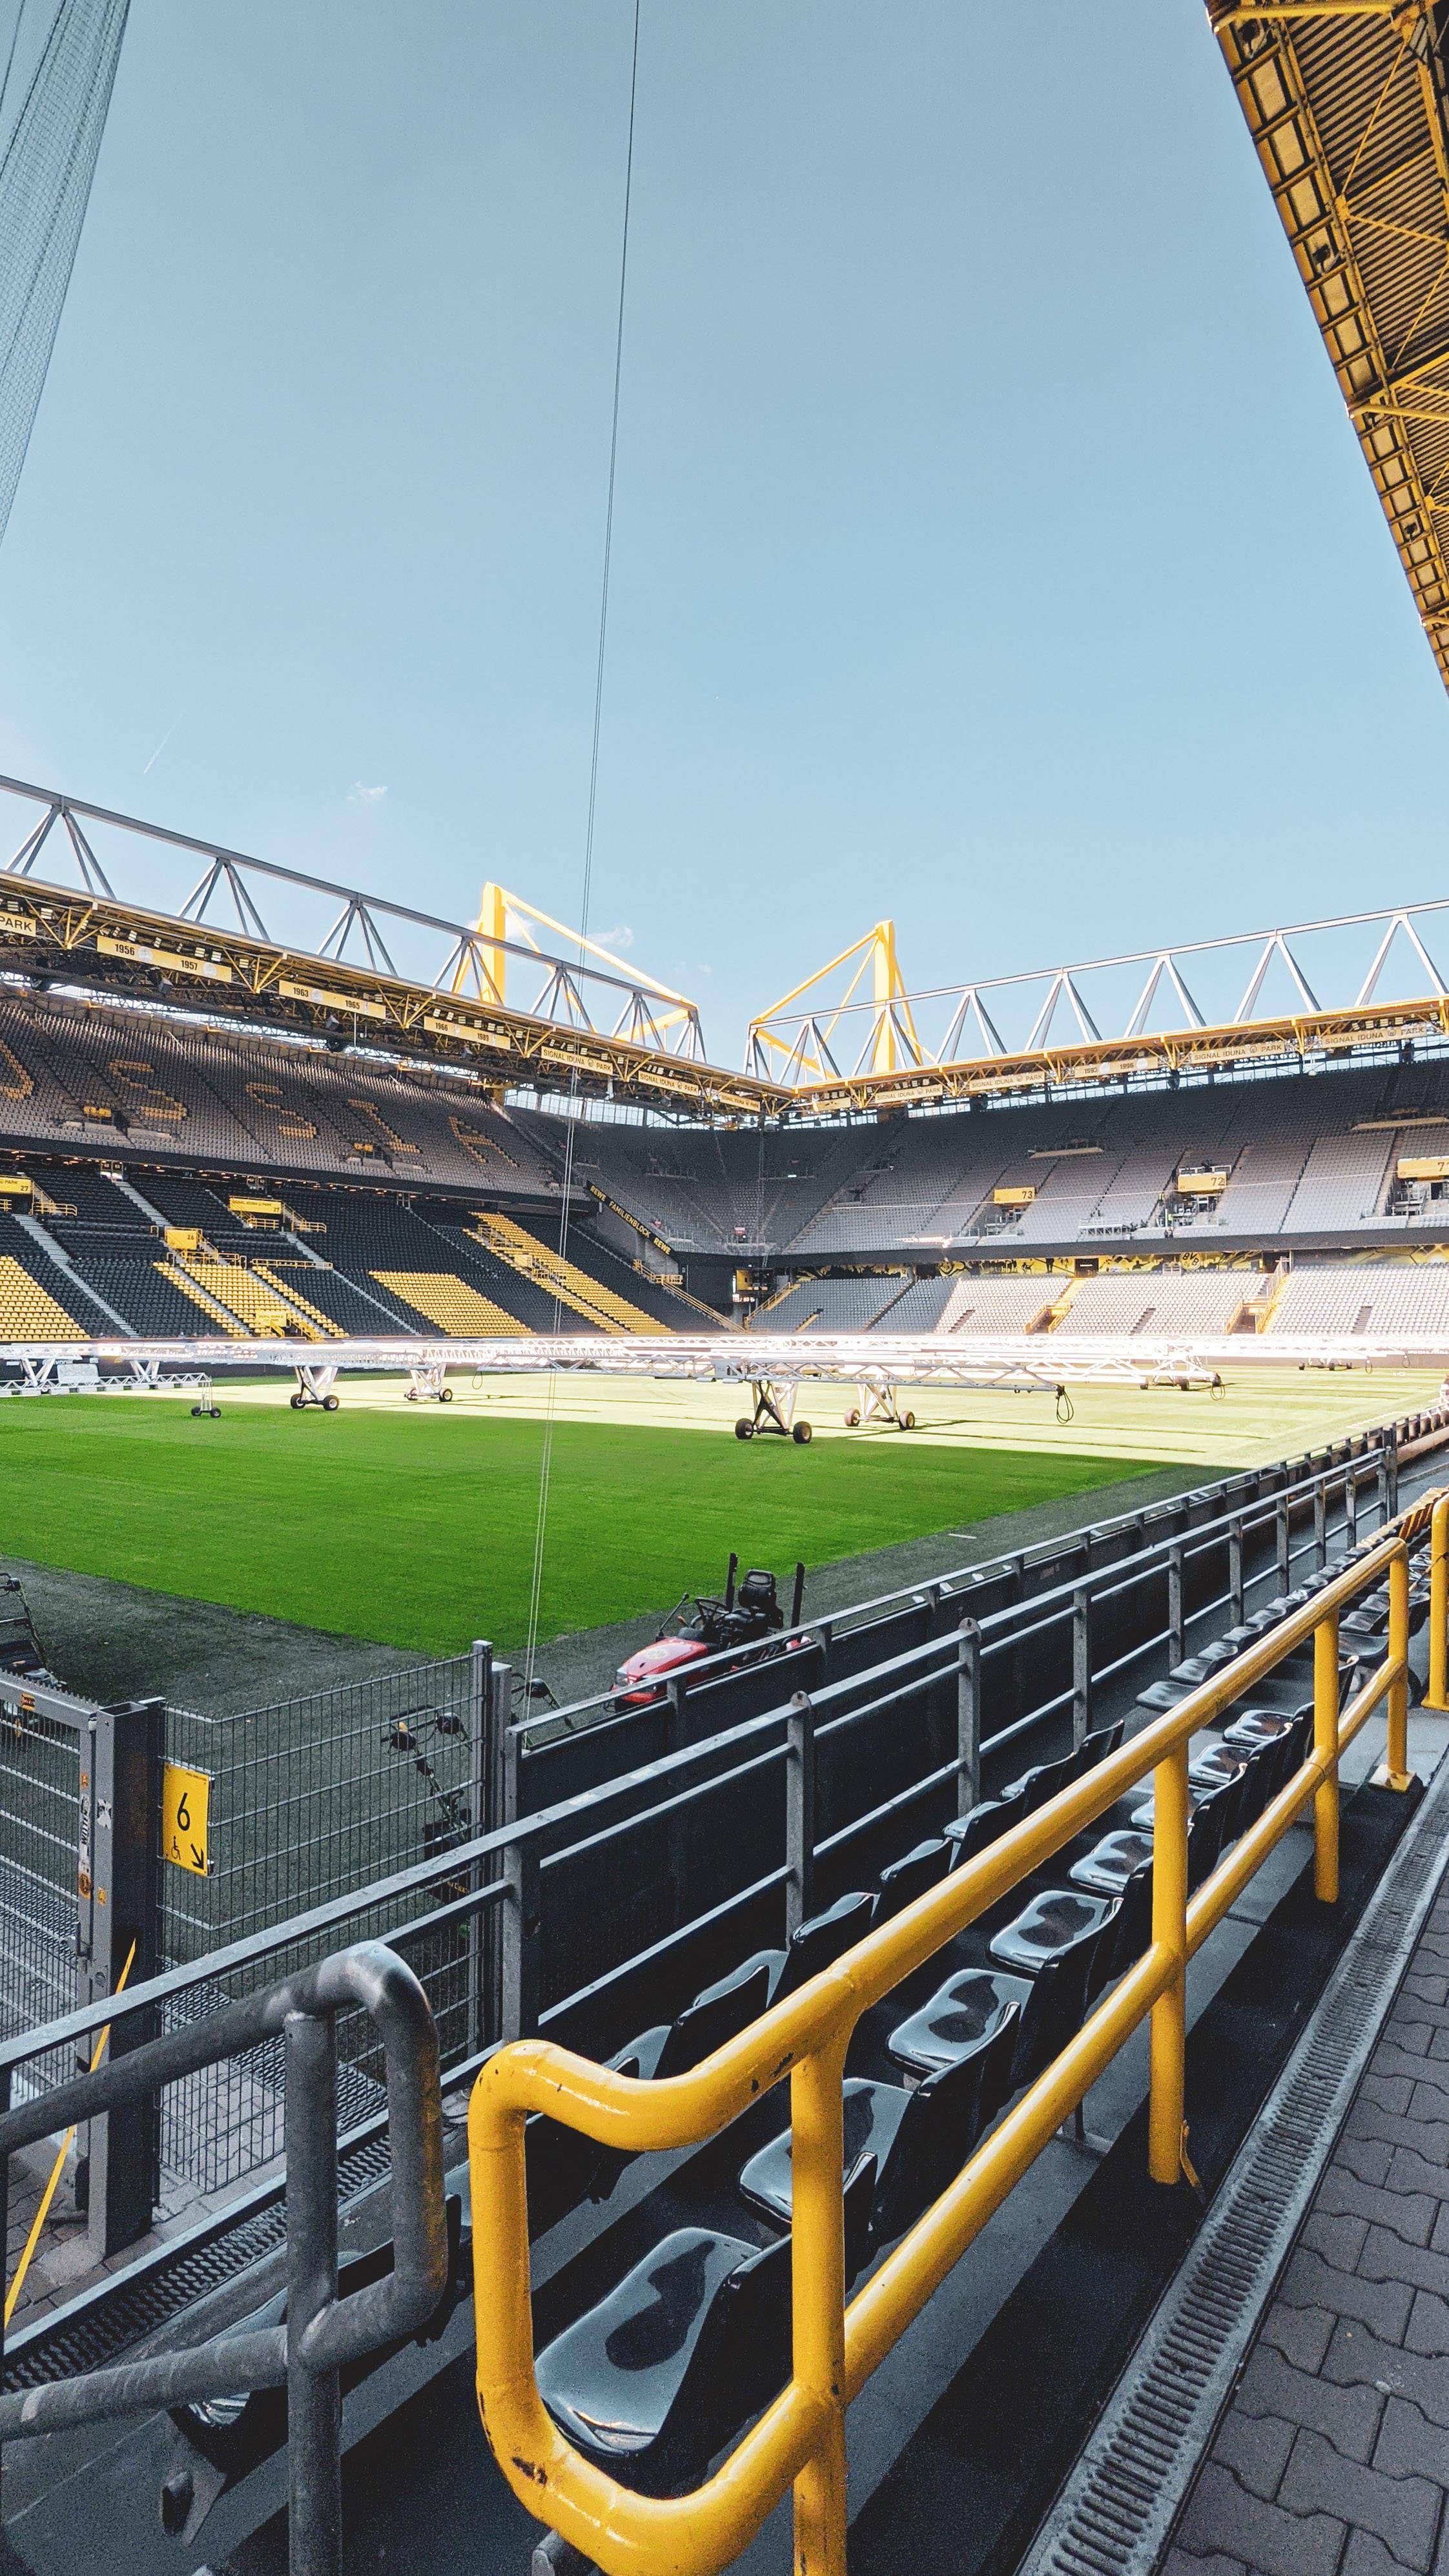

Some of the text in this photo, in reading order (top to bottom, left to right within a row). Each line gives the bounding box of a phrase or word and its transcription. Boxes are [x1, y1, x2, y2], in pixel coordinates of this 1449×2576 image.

[115, 943, 198, 971] 1956 1957
[293, 987, 360, 1009] 1963 1965
[435, 1022, 448, 1031] 1966
[1325, 1036, 1355, 1045] SIGNAL
[1357, 1032, 1383, 1041] IDUNA
[543, 1049, 611, 1071] SIGNAL IDUNA PARK
[640, 1073, 697, 1093] SIGNAL IDUNA PARK
[878, 1093, 896, 1101] SIGNAL
[1437, 1162, 1449, 1171] 7
[1211, 1177, 1225, 1186] 72
[1022, 1190, 1033, 1199] 73
[590, 1185, 672, 1255] REWE FAMILIENBLOCK REWE
[1182, 1253, 1199, 1266] BVB
[177, 1792, 190, 1831] 6
